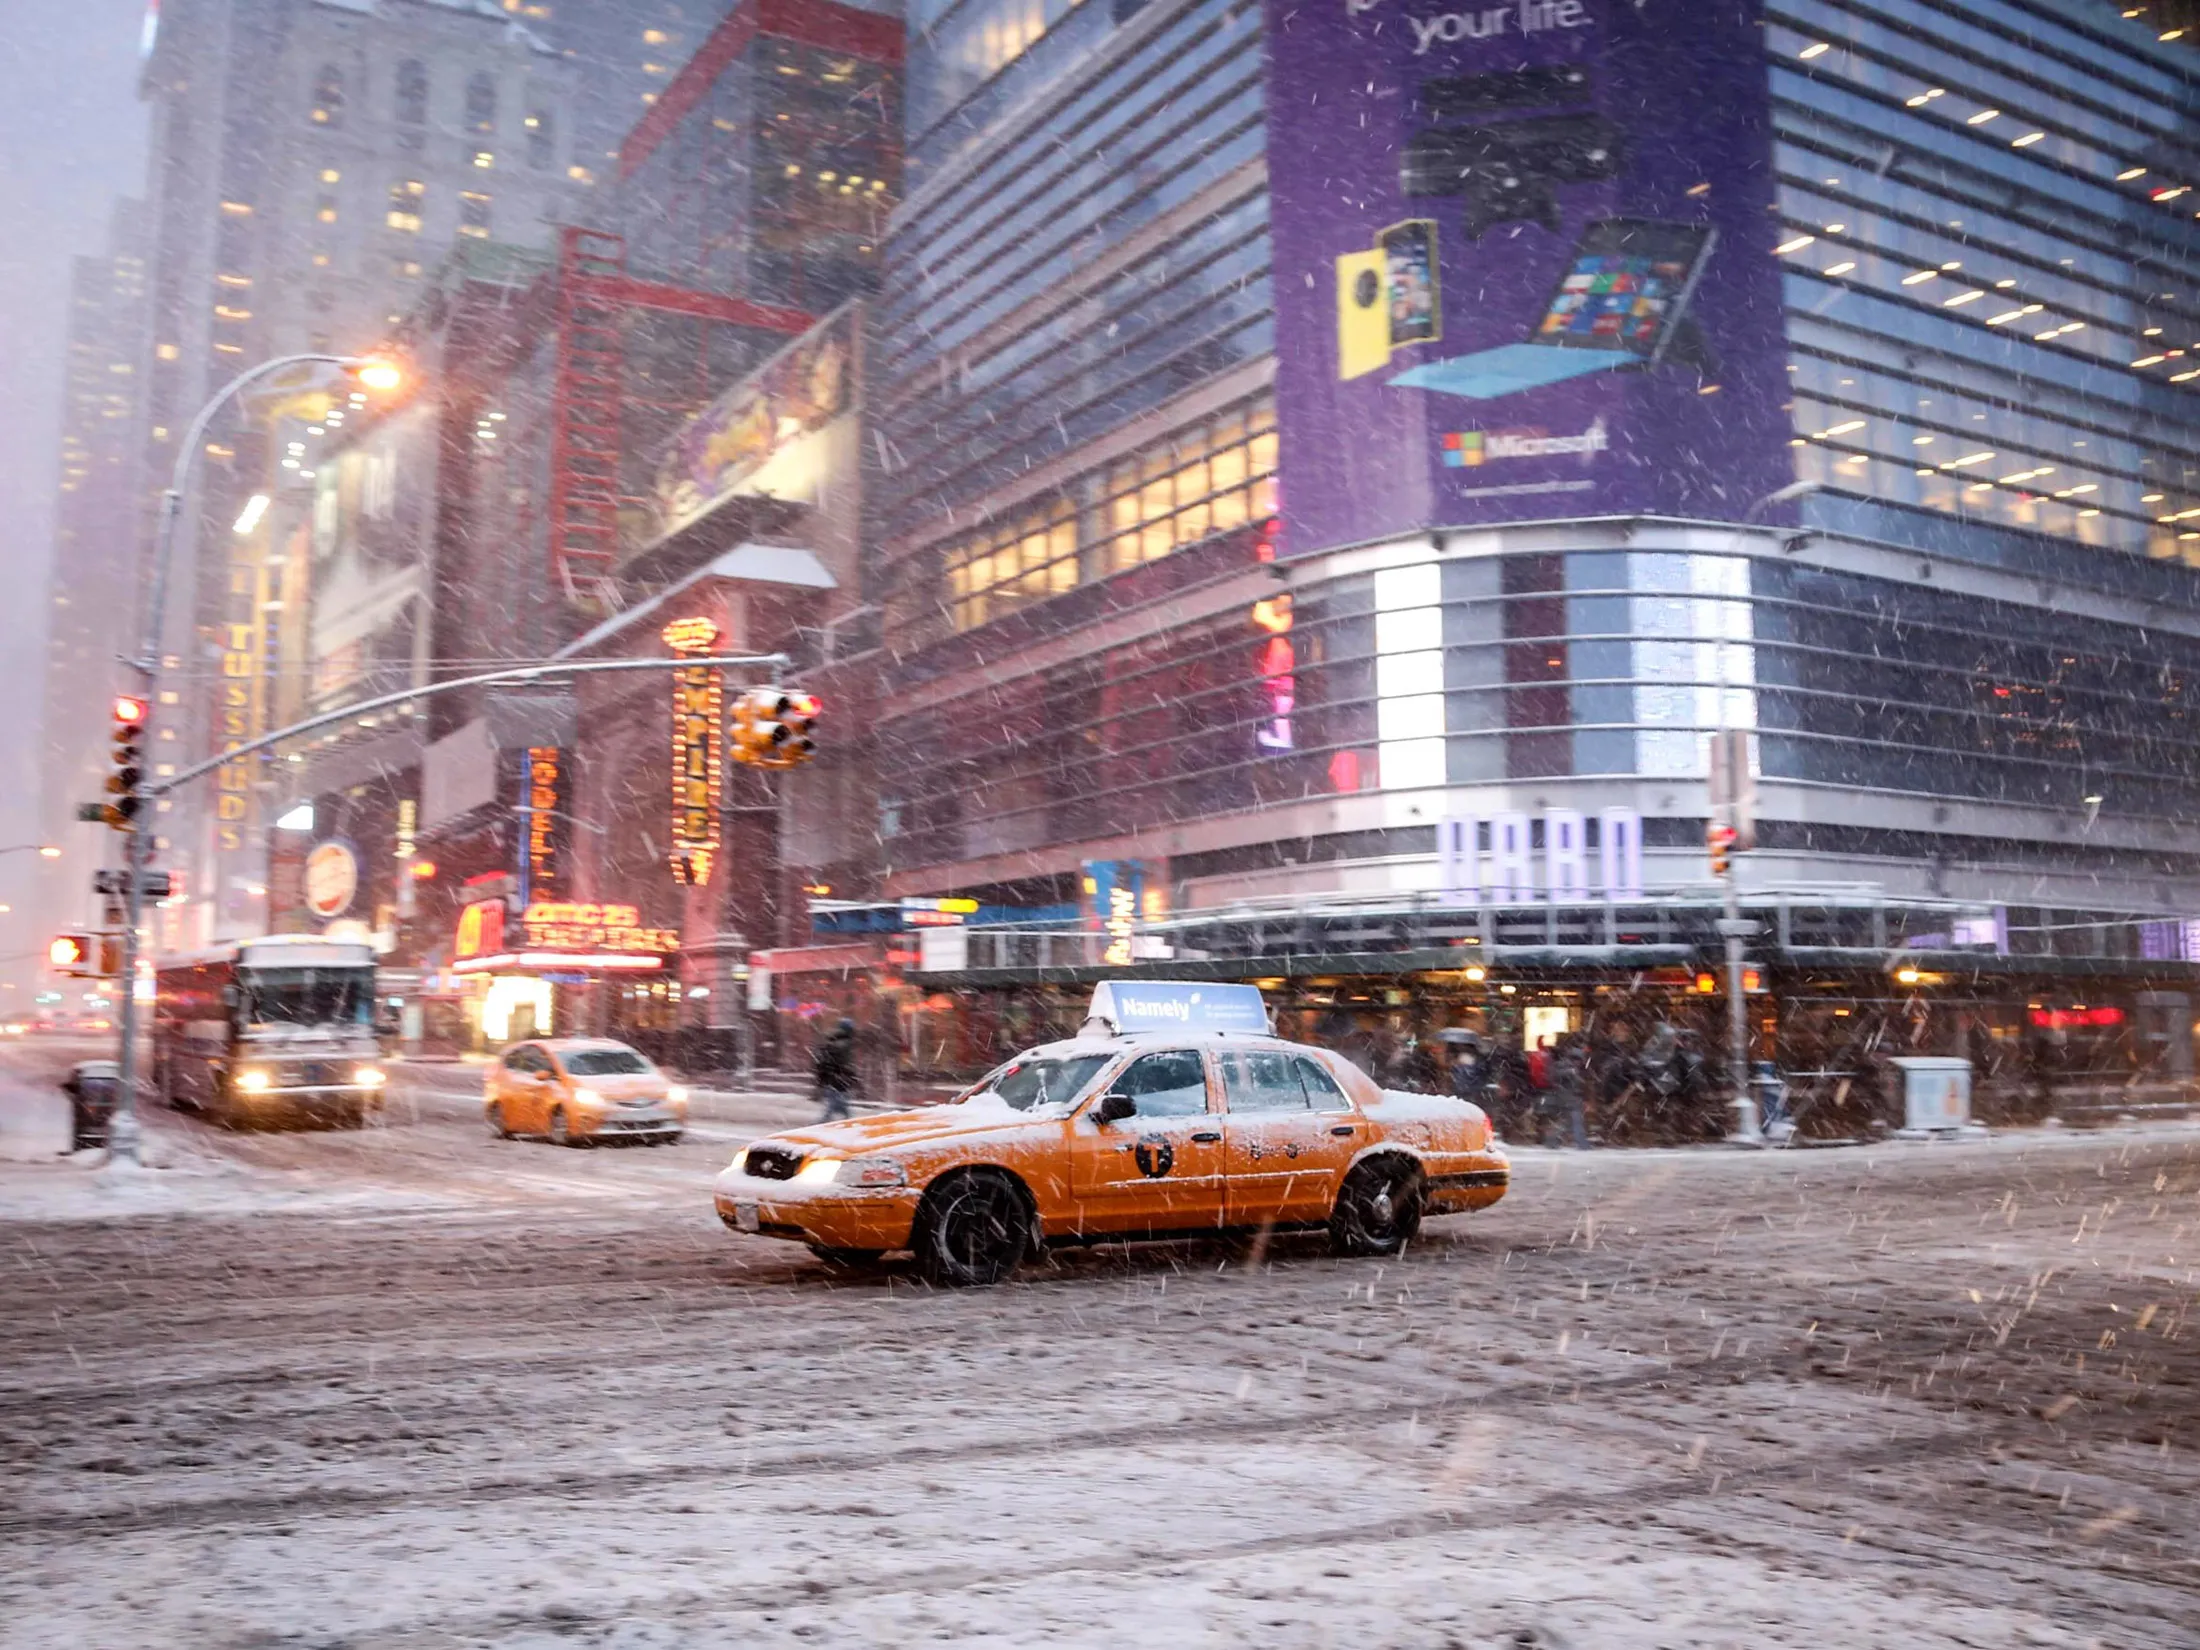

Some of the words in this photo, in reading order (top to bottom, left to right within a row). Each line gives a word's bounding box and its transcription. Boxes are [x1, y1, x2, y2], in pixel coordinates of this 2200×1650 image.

[1403, 7, 1513, 55] your
[1485, 427, 1609, 459] Microsoft
[1121, 997, 1190, 1022] Namely
